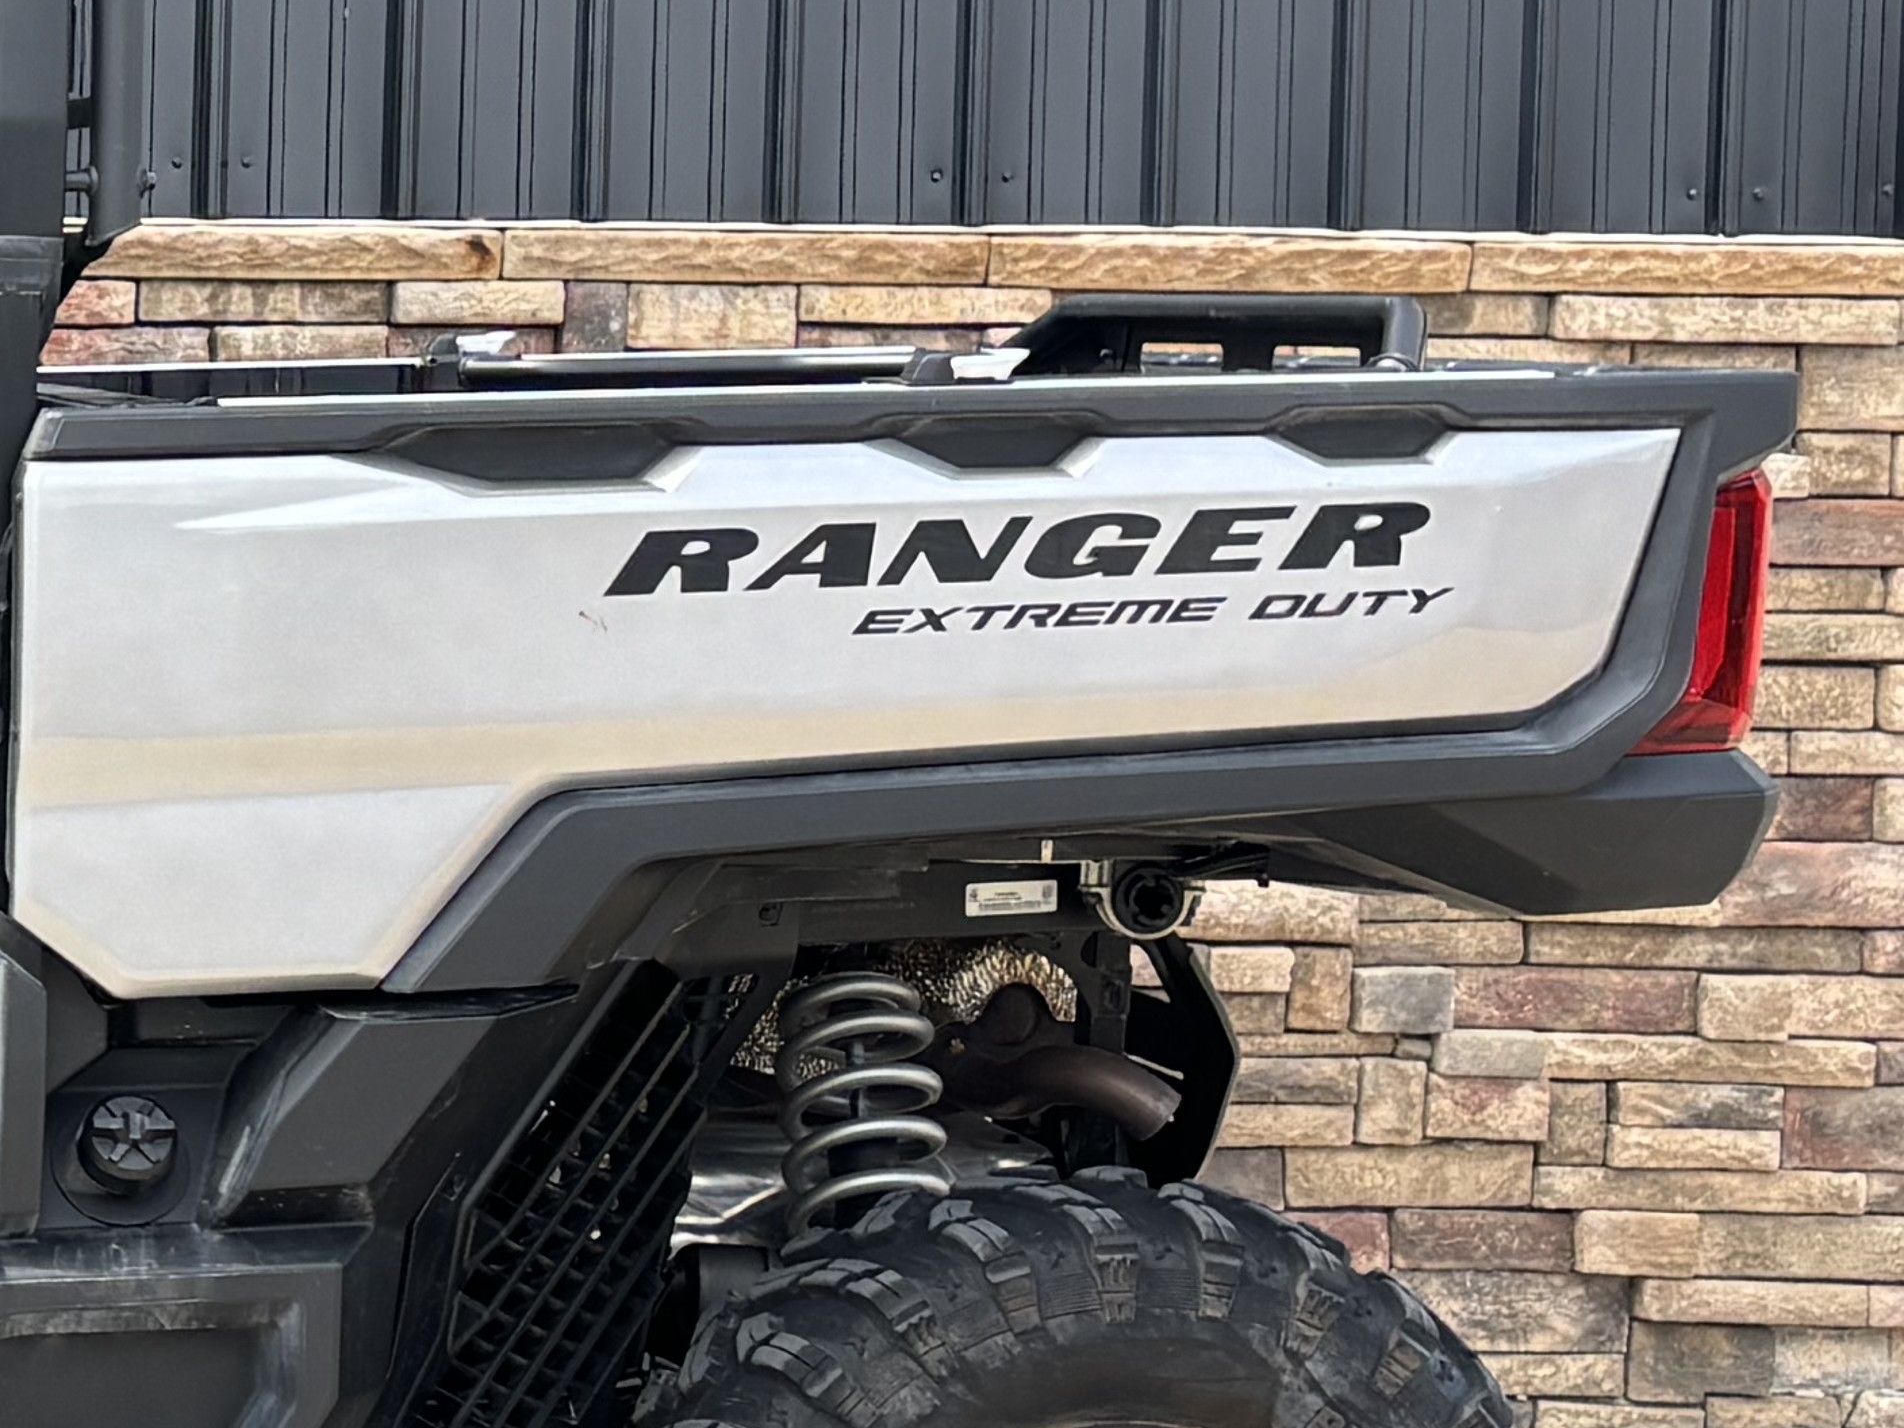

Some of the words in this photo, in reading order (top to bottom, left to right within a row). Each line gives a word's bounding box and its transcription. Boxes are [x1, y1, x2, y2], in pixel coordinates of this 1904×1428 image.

[604, 502, 1431, 595] RANGER
[852, 597, 1227, 635] EXTREME
[1248, 587, 1454, 620] DUTY
